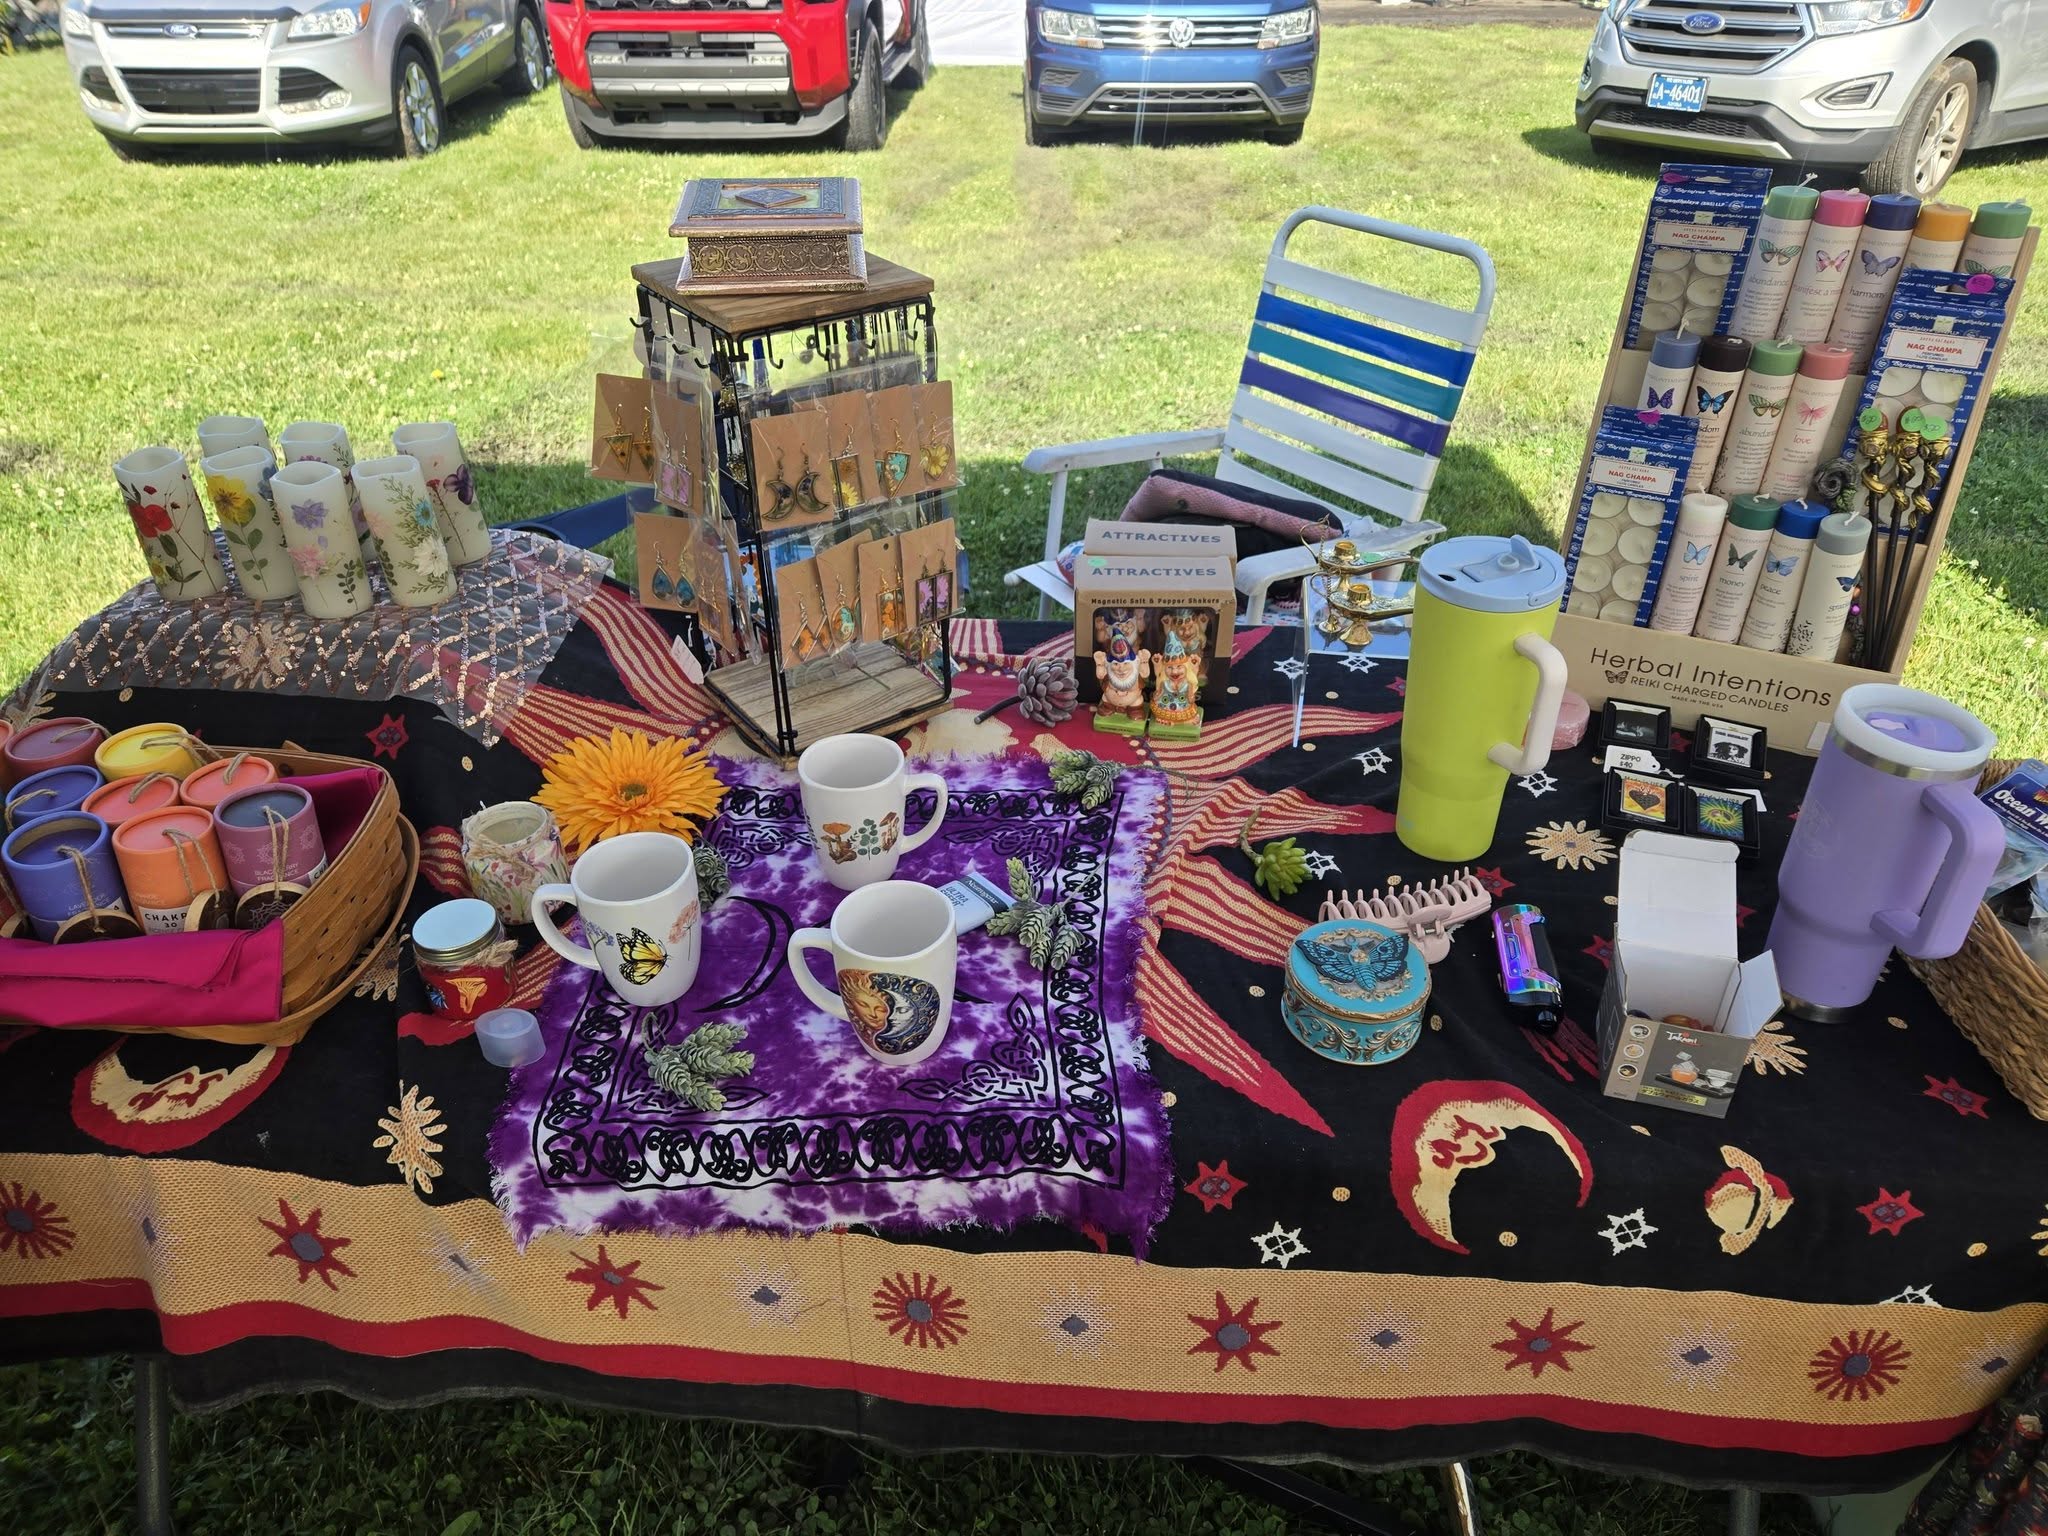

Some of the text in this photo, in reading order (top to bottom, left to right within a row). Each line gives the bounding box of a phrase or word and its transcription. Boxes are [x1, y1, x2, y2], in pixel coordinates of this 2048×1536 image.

[1690, 16, 1714, 28] Ford
[1672, 232, 1726, 242] NAG CHAMPA
[1907, 342, 1963, 355] NAG CHAMPA
[1700, 424, 1721, 433] sdom
[1793, 434, 1811, 445] love
[1608, 470, 1656, 483] NAG CHAMPA
[1102, 531, 1221, 543] ATTRACTIVES
[1092, 567, 1217, 577] ATTRACTIVES
[1679, 573, 1699, 585] spirit
[1720, 576, 1745, 588] money
[1760, 583, 1782, 595] peace
[1590, 647, 1832, 707] Herbal Intentions
[1630, 675, 1790, 712] REIKI CHARGED CANDLES
[1620, 753, 1641, 762] ZIPPO
[1620, 761, 1633, 769] $40
[1994, 789, 2037, 817] Ocean
[945, 886, 969, 904] ULTRA
[144, 912, 187, 921] CHAKR
